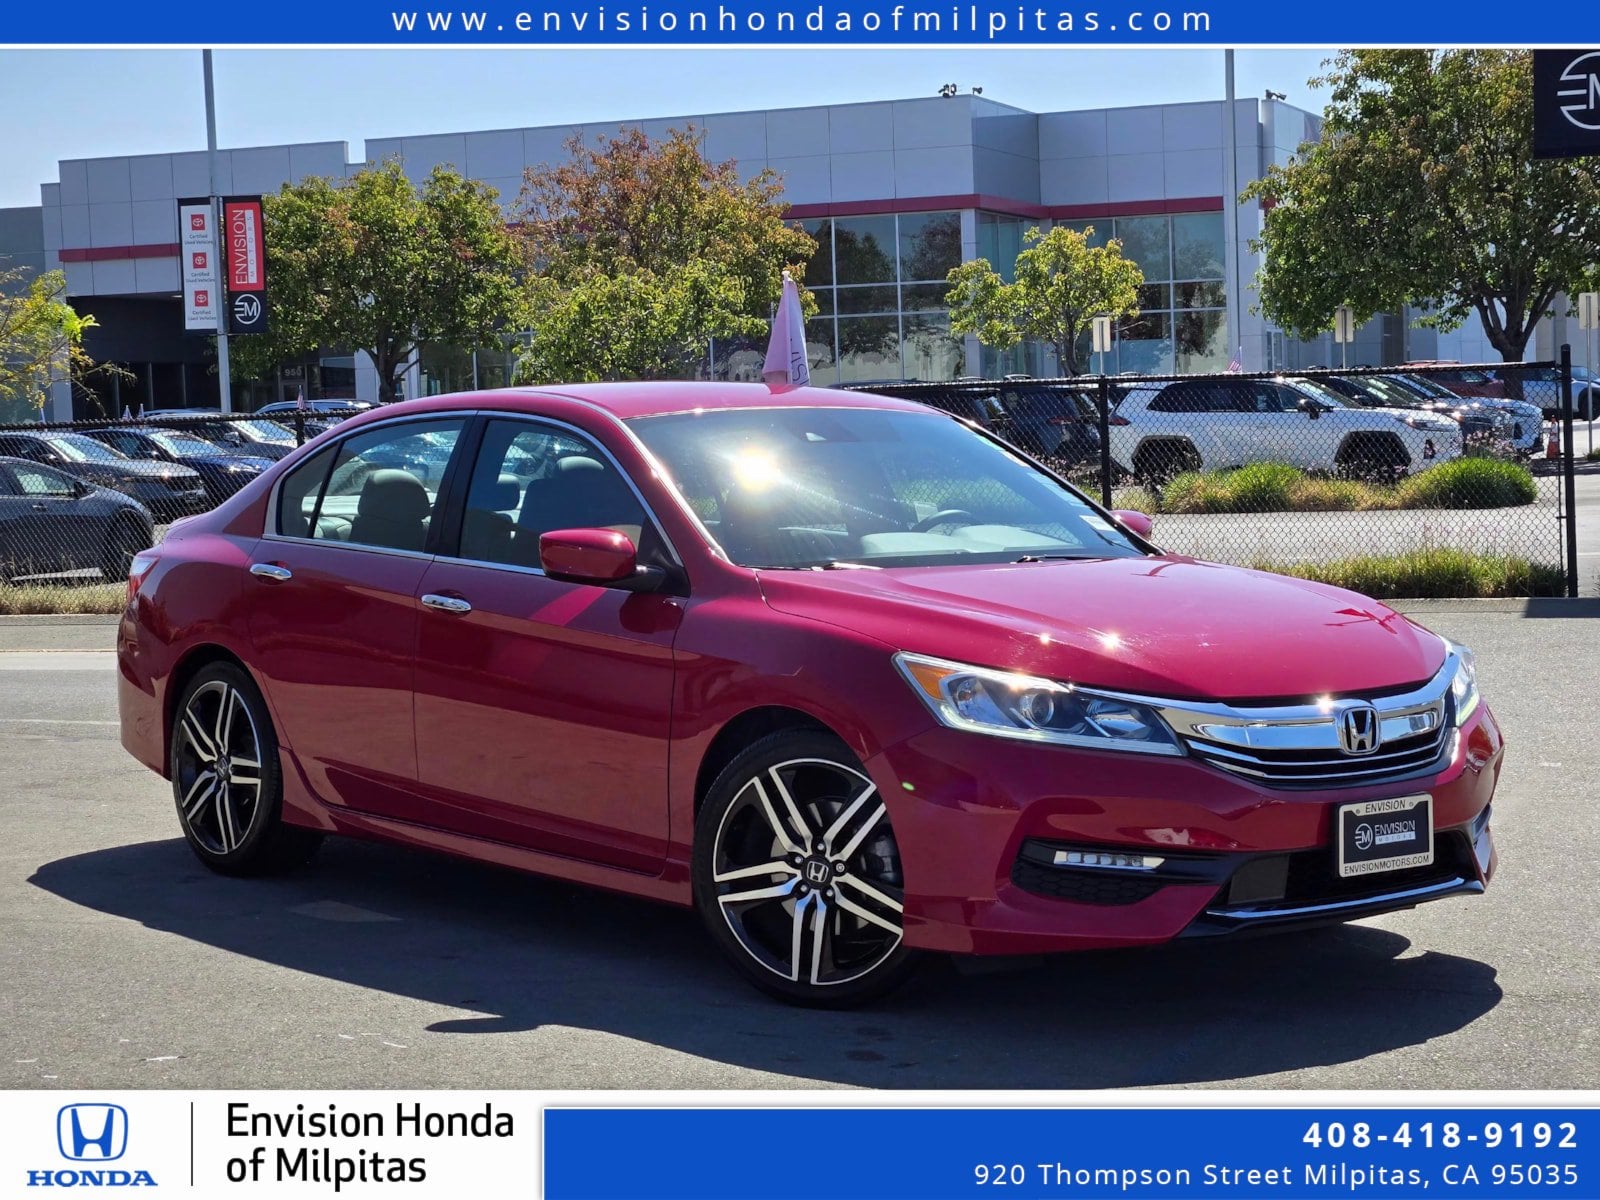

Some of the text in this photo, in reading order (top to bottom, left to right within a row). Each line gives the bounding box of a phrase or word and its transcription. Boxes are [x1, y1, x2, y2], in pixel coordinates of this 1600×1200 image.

[232, 210, 248, 284] ENVISION
[1365, 800, 1406, 814] ENVISION
[1374, 820, 1416, 836] ENVISION
[1344, 854, 1430, 875] ENVISIONMOTORS.COM
